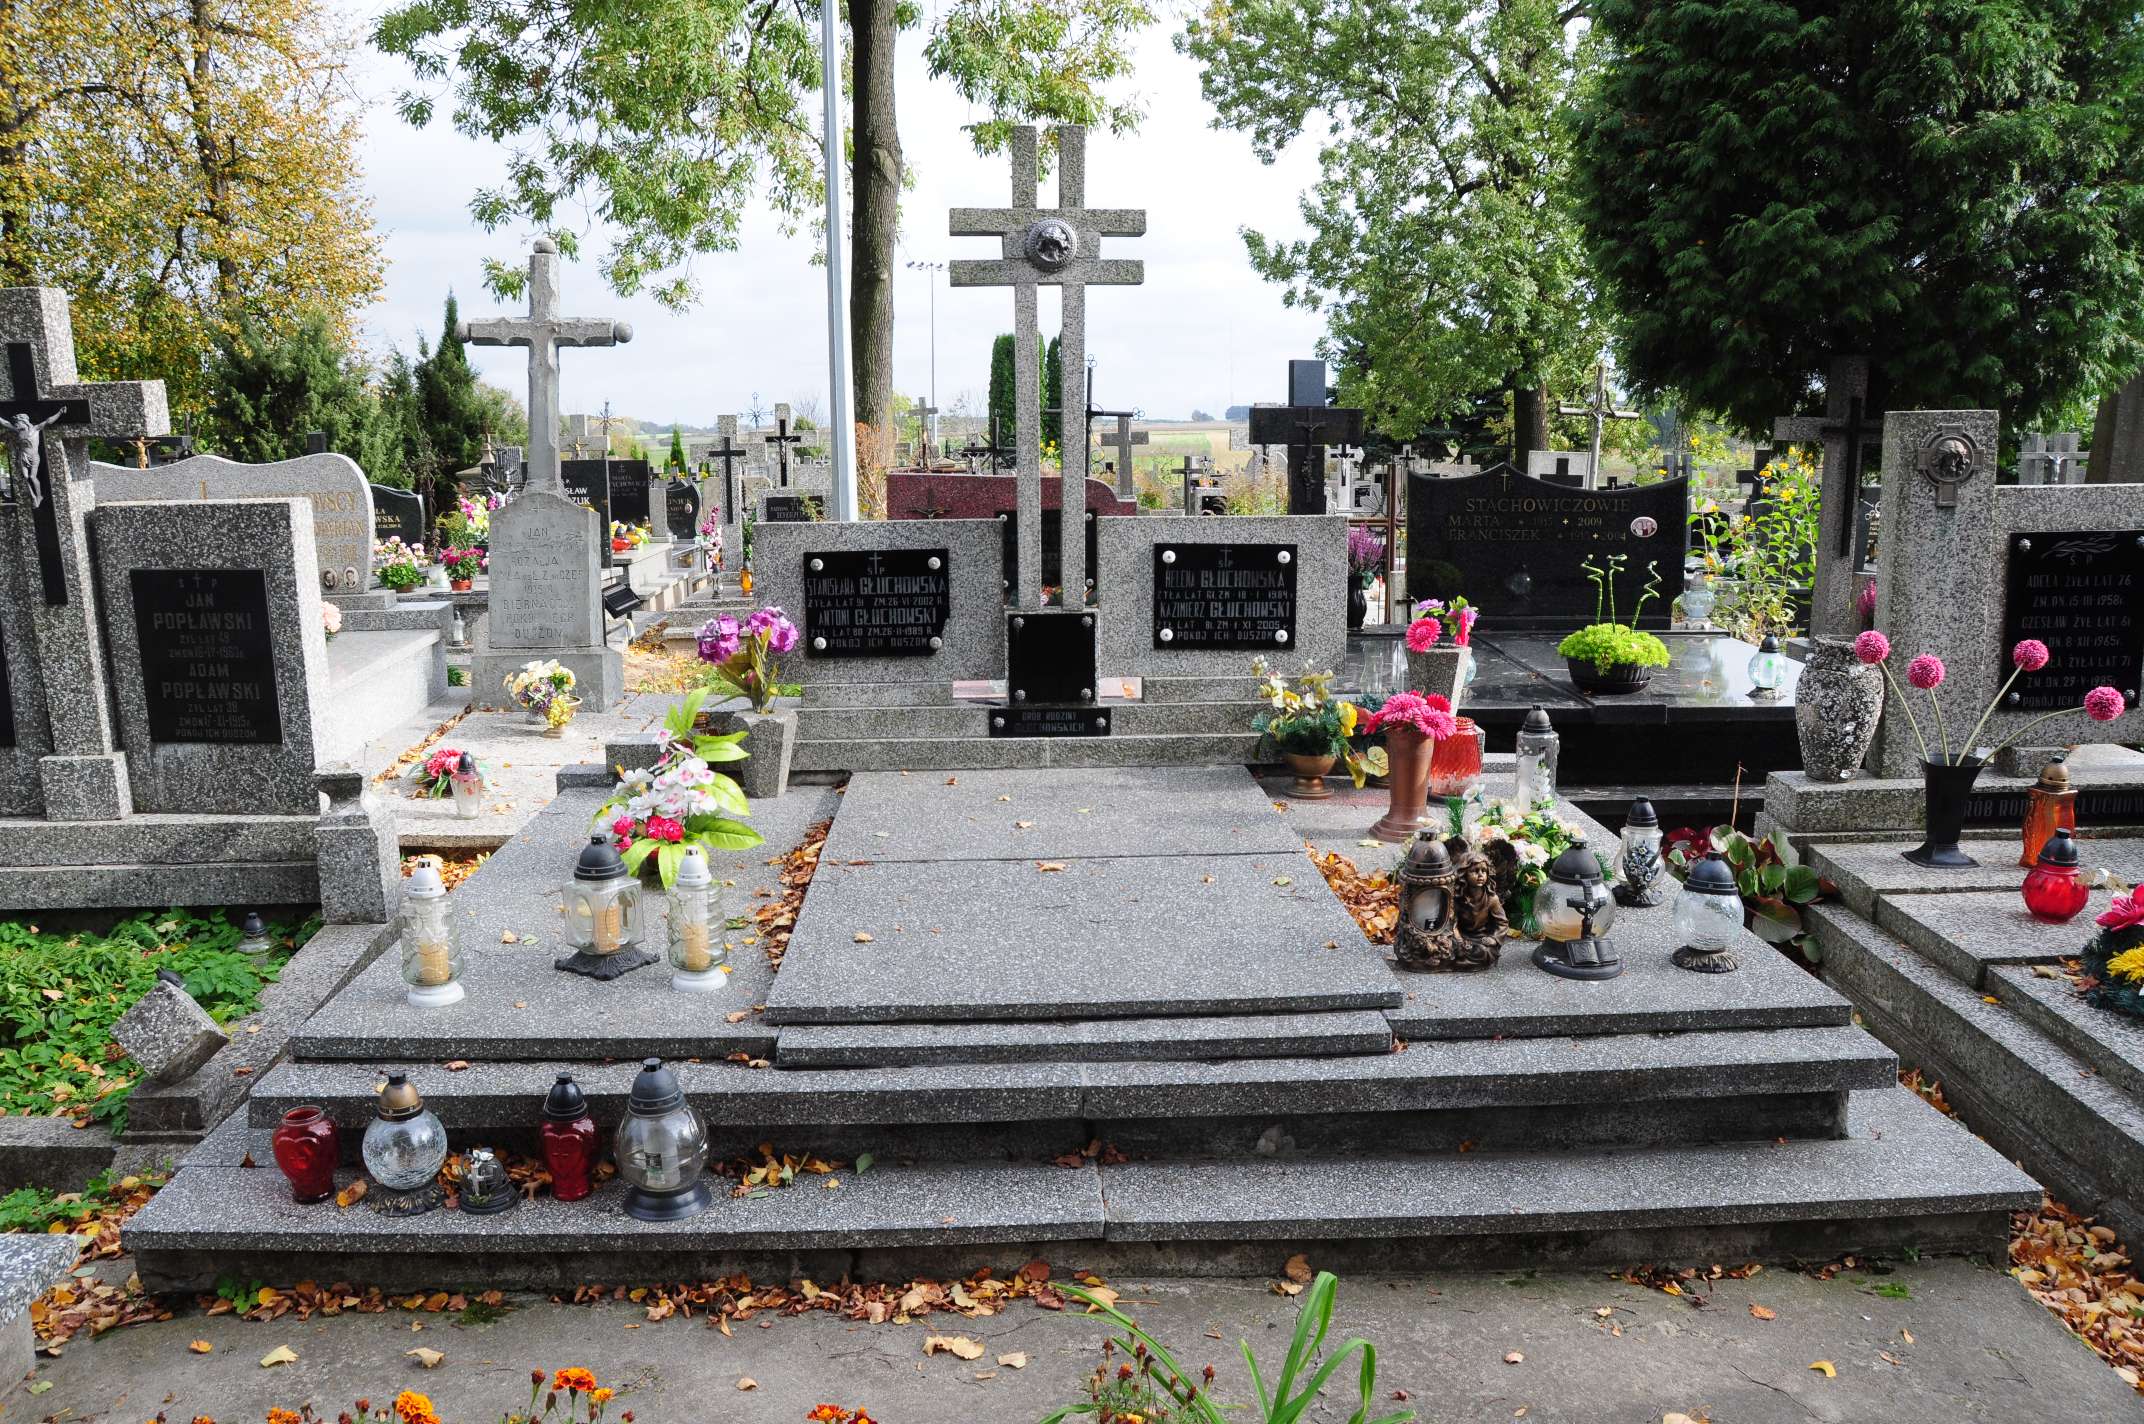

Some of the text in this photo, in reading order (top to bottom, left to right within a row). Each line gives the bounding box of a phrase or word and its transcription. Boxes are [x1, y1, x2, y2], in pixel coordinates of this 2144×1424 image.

[1465, 498, 1632, 513] STACHOWICZOWIE
[1449, 515, 1500, 527] MARTA
[1578, 516, 1603, 527] 2009
[527, 527, 548, 538] JAN
[1449, 529, 1541, 541] FRANCISZEK
[1165, 569, 1286, 588] HELENA GŁUCHOWSKA
[2094, 575, 2113, 586] LAT
[807, 575, 947, 596] STANISŁAWA GŁUCHOWSKA
[186, 593, 215, 608] JAN
[1184, 590, 1203, 600] LAT
[836, 598, 854, 608] LAT
[1160, 601, 1290, 618] KAZIMIERZ GŁUCHOWSKI
[153, 612, 252, 630] POPŁAWSKI
[818, 607, 937, 626] ANTONI GŁUCHOWSKI
[2022, 616, 2067, 629] CZESŁAW
[2097, 616, 2117, 628] LAT
[1177, 620, 1196, 630] LAT
[1257, 620, 1280, 630] 2005
[832, 628, 852, 637] LAT
[1214, 630, 1229, 641] ICH
[1237, 630, 1273, 641] DUSZOM
[890, 638, 929, 648] DUSZOM
[2097, 656, 2117, 668] LAT
[189, 664, 230, 677] ADAM
[162, 682, 261, 700] POPŁAWSKI
